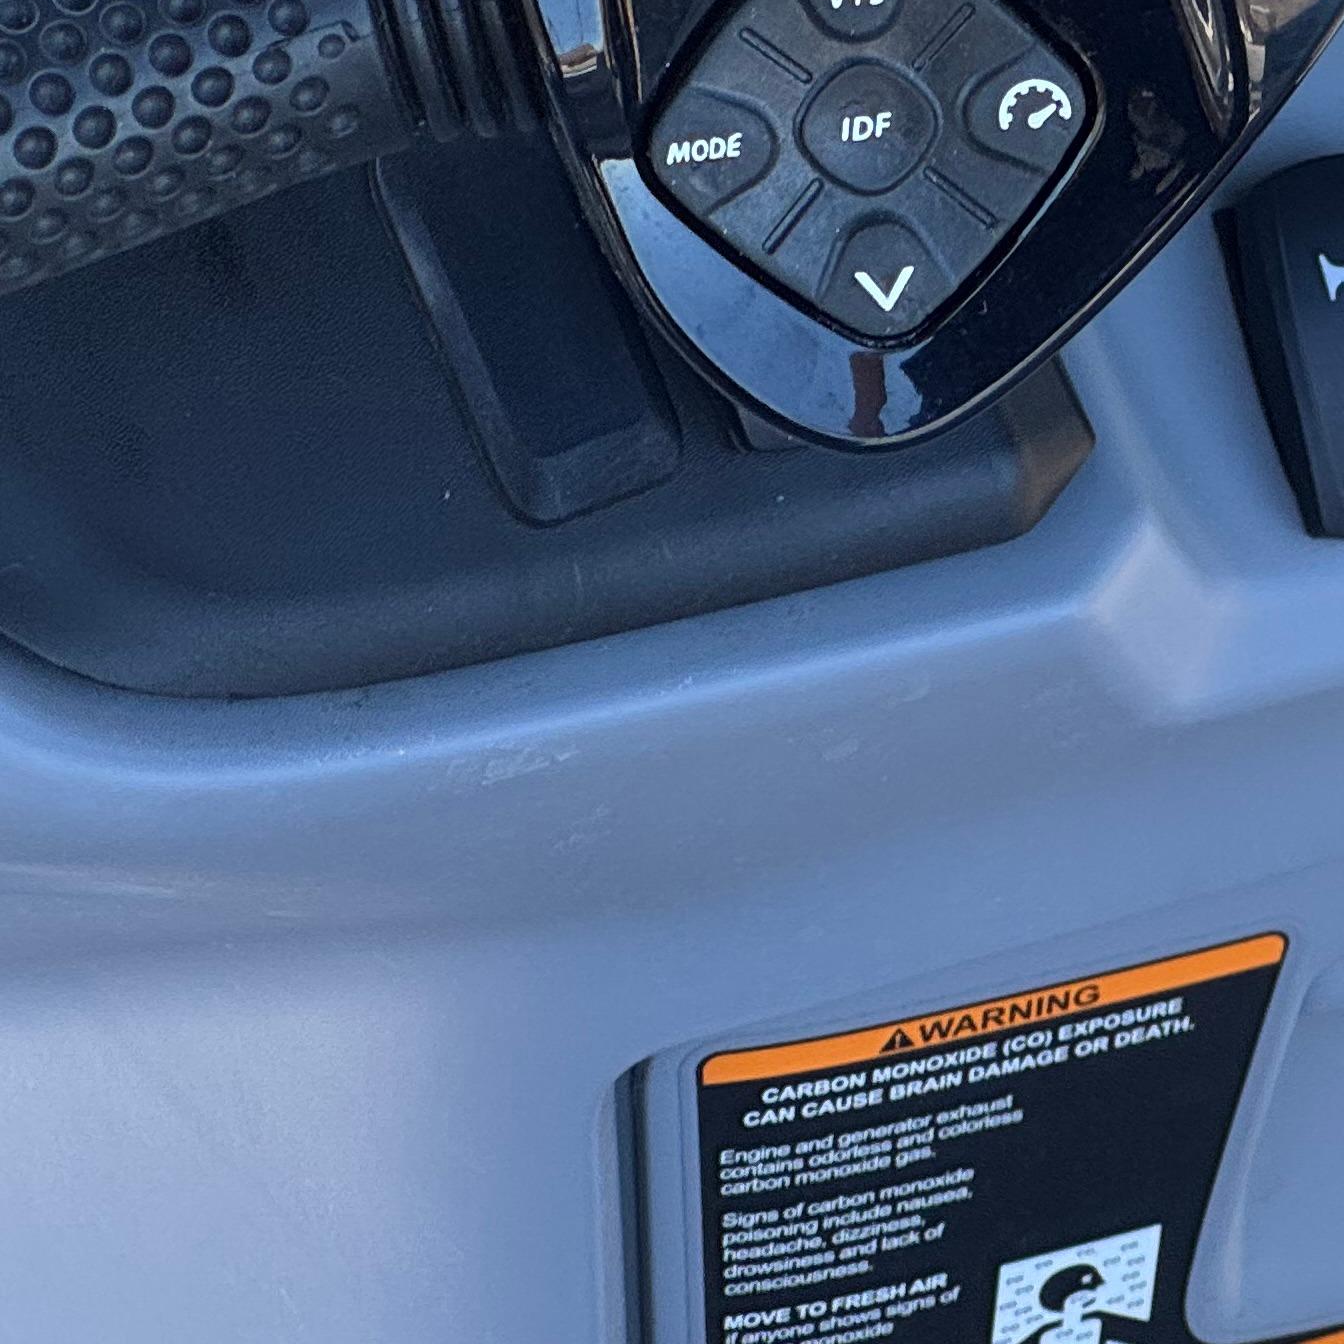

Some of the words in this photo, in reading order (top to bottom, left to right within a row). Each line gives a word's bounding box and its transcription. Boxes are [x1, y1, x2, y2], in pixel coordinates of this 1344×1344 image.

[666, 132, 743, 165] MODE
[840, 112, 892, 142] IDF
[918, 983, 1101, 1043] WARNING
[742, 1105, 796, 1128] CAN
[800, 1088, 884, 1119] CAUSE
[889, 1070, 963, 1102] BRAIN
[967, 1045, 1070, 1084] DAMAGE
[1074, 1035, 1110, 1058] OR
[1113, 1015, 1196, 1050] DEATH.
[761, 1071, 867, 1104] CARBON
[871, 1042, 999, 1084] MONOXIDE
[1002, 1028, 1052, 1056] (CO)
[1057, 996, 1185, 1042] EXPOSURE
[719, 1143, 792, 1166] Engine
[795, 1133, 835, 1155] and
[838, 1114, 934, 1149] generator
[719, 1157, 805, 1180] contains
[896, 1127, 935, 1150] and
[720, 1174, 791, 1196] carbon
[794, 1155, 892, 1186] monoxide
[722, 1209, 780, 1229] Signs
[782, 1202, 806, 1220] of
[807, 1190, 876, 1217] carbon
[723, 1307, 792, 1331] MOVE
[795, 1299, 828, 1320] TO
[830, 1282, 907, 1313] FRESH
[908, 1271, 949, 1296] AIR
